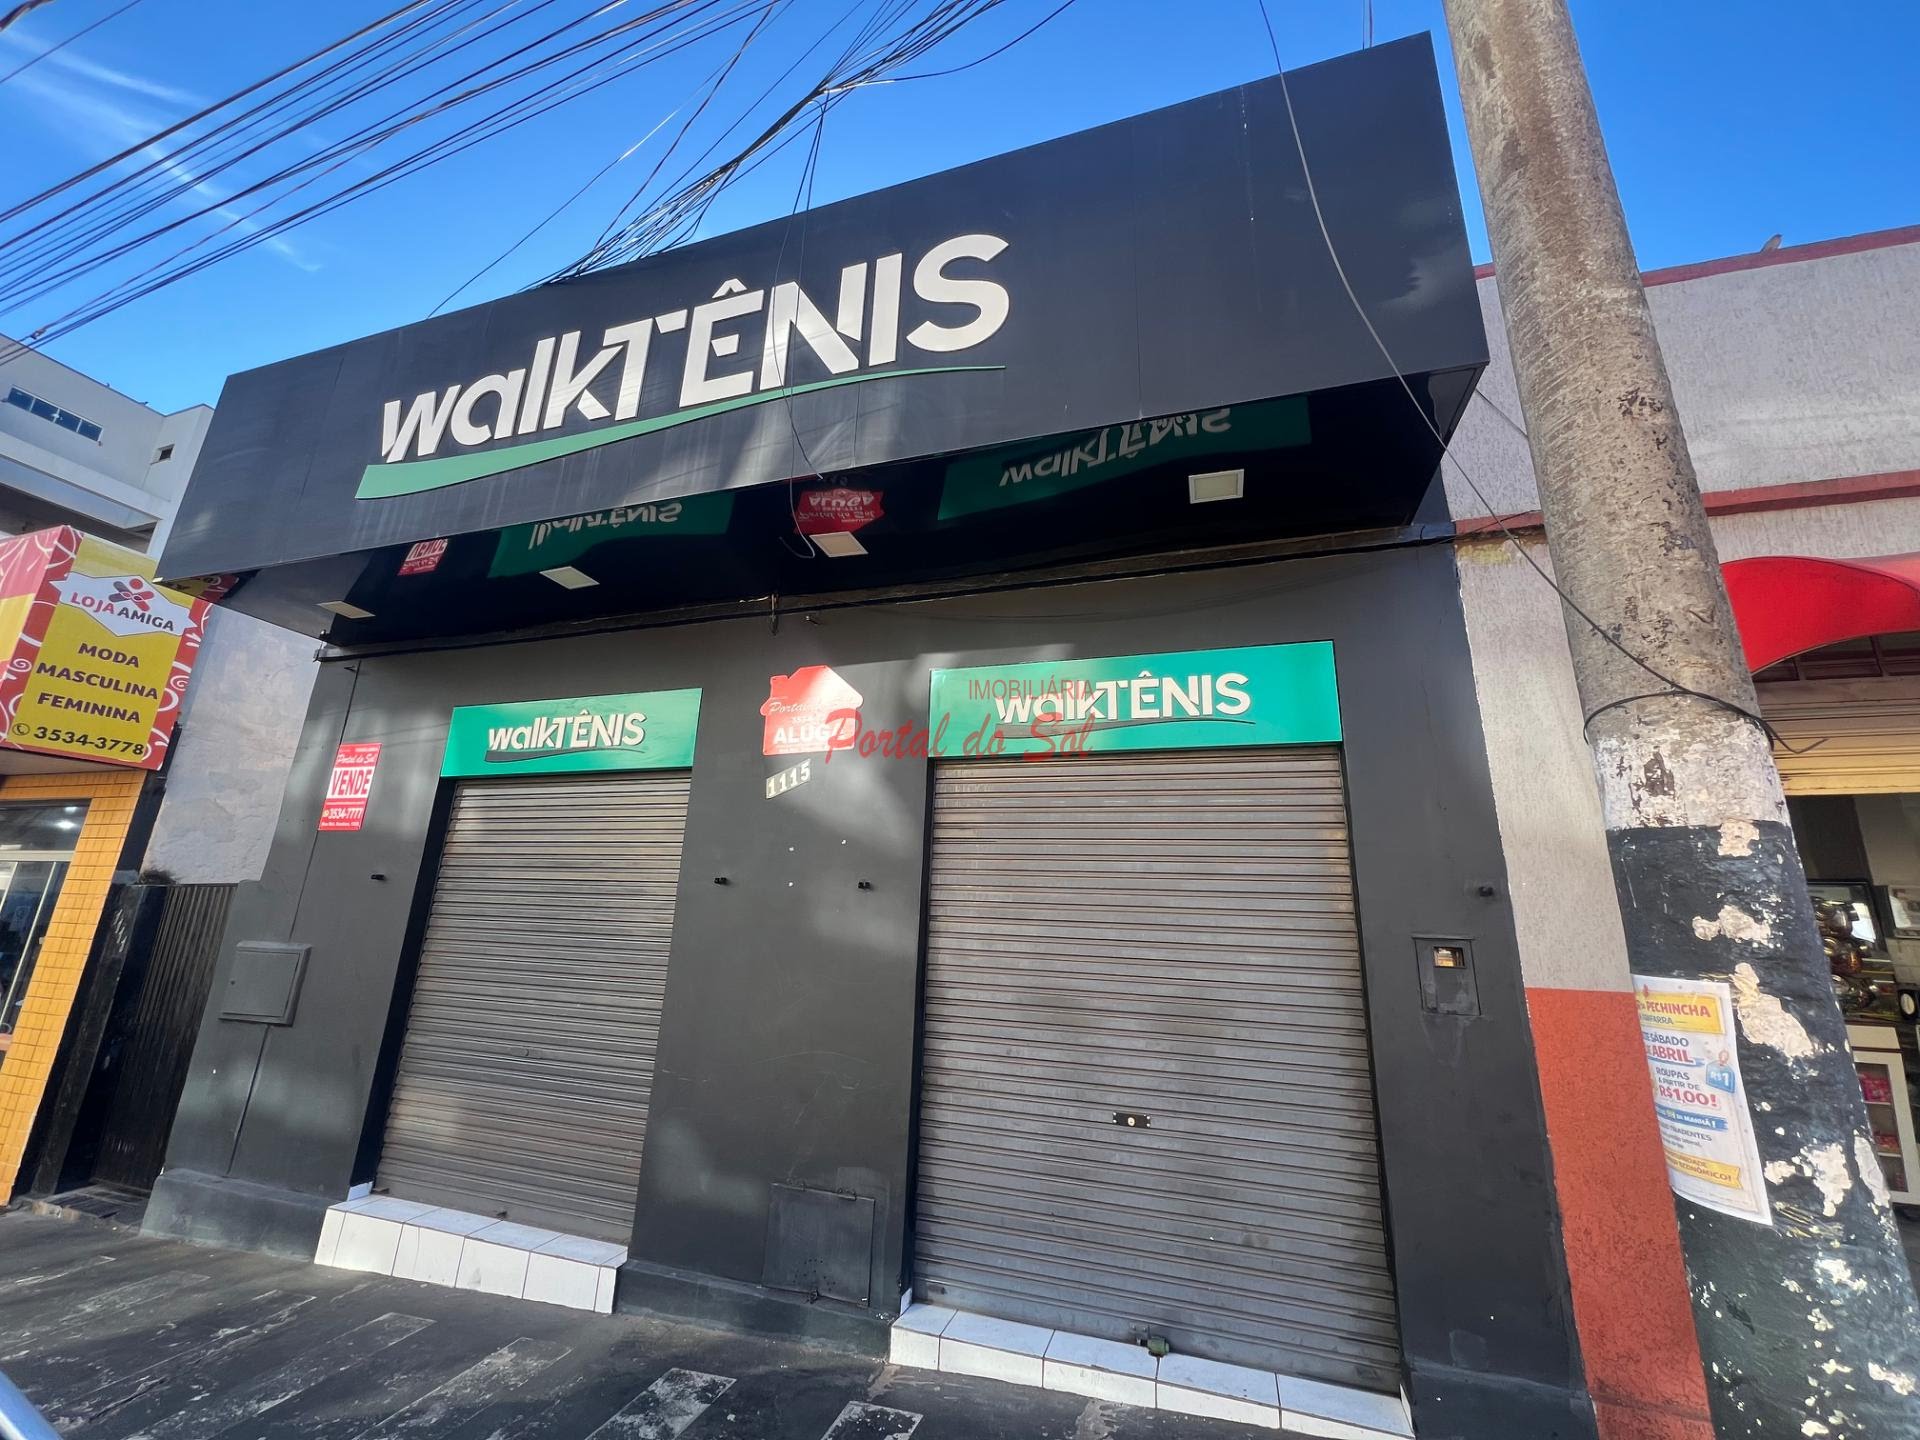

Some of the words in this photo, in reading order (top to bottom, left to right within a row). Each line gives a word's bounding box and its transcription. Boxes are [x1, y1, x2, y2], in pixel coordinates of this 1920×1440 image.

[381, 233, 1011, 463] walkTÊNIS
[70, 591, 115, 615] LOJA
[117, 604, 175, 632] AMIGA
[78, 642, 140, 669] MODA
[36, 662, 159, 700] MASCULINA
[37, 692, 141, 724] FEMININA
[995, 670, 1253, 724] walkTÊNIS
[33, 726, 146, 756] 3534-3778
[487, 708, 648, 751] walkTÊNIS
[331, 769, 373, 796] VENDE
[768, 761, 811, 798] 1115
[1646, 1000, 1711, 1018] PECHINCHA
[1650, 1031, 1690, 1047] SÁBADO
[1652, 1044, 1694, 1064] ABRIL
[1655, 1066, 1690, 1080] ROUPAS
